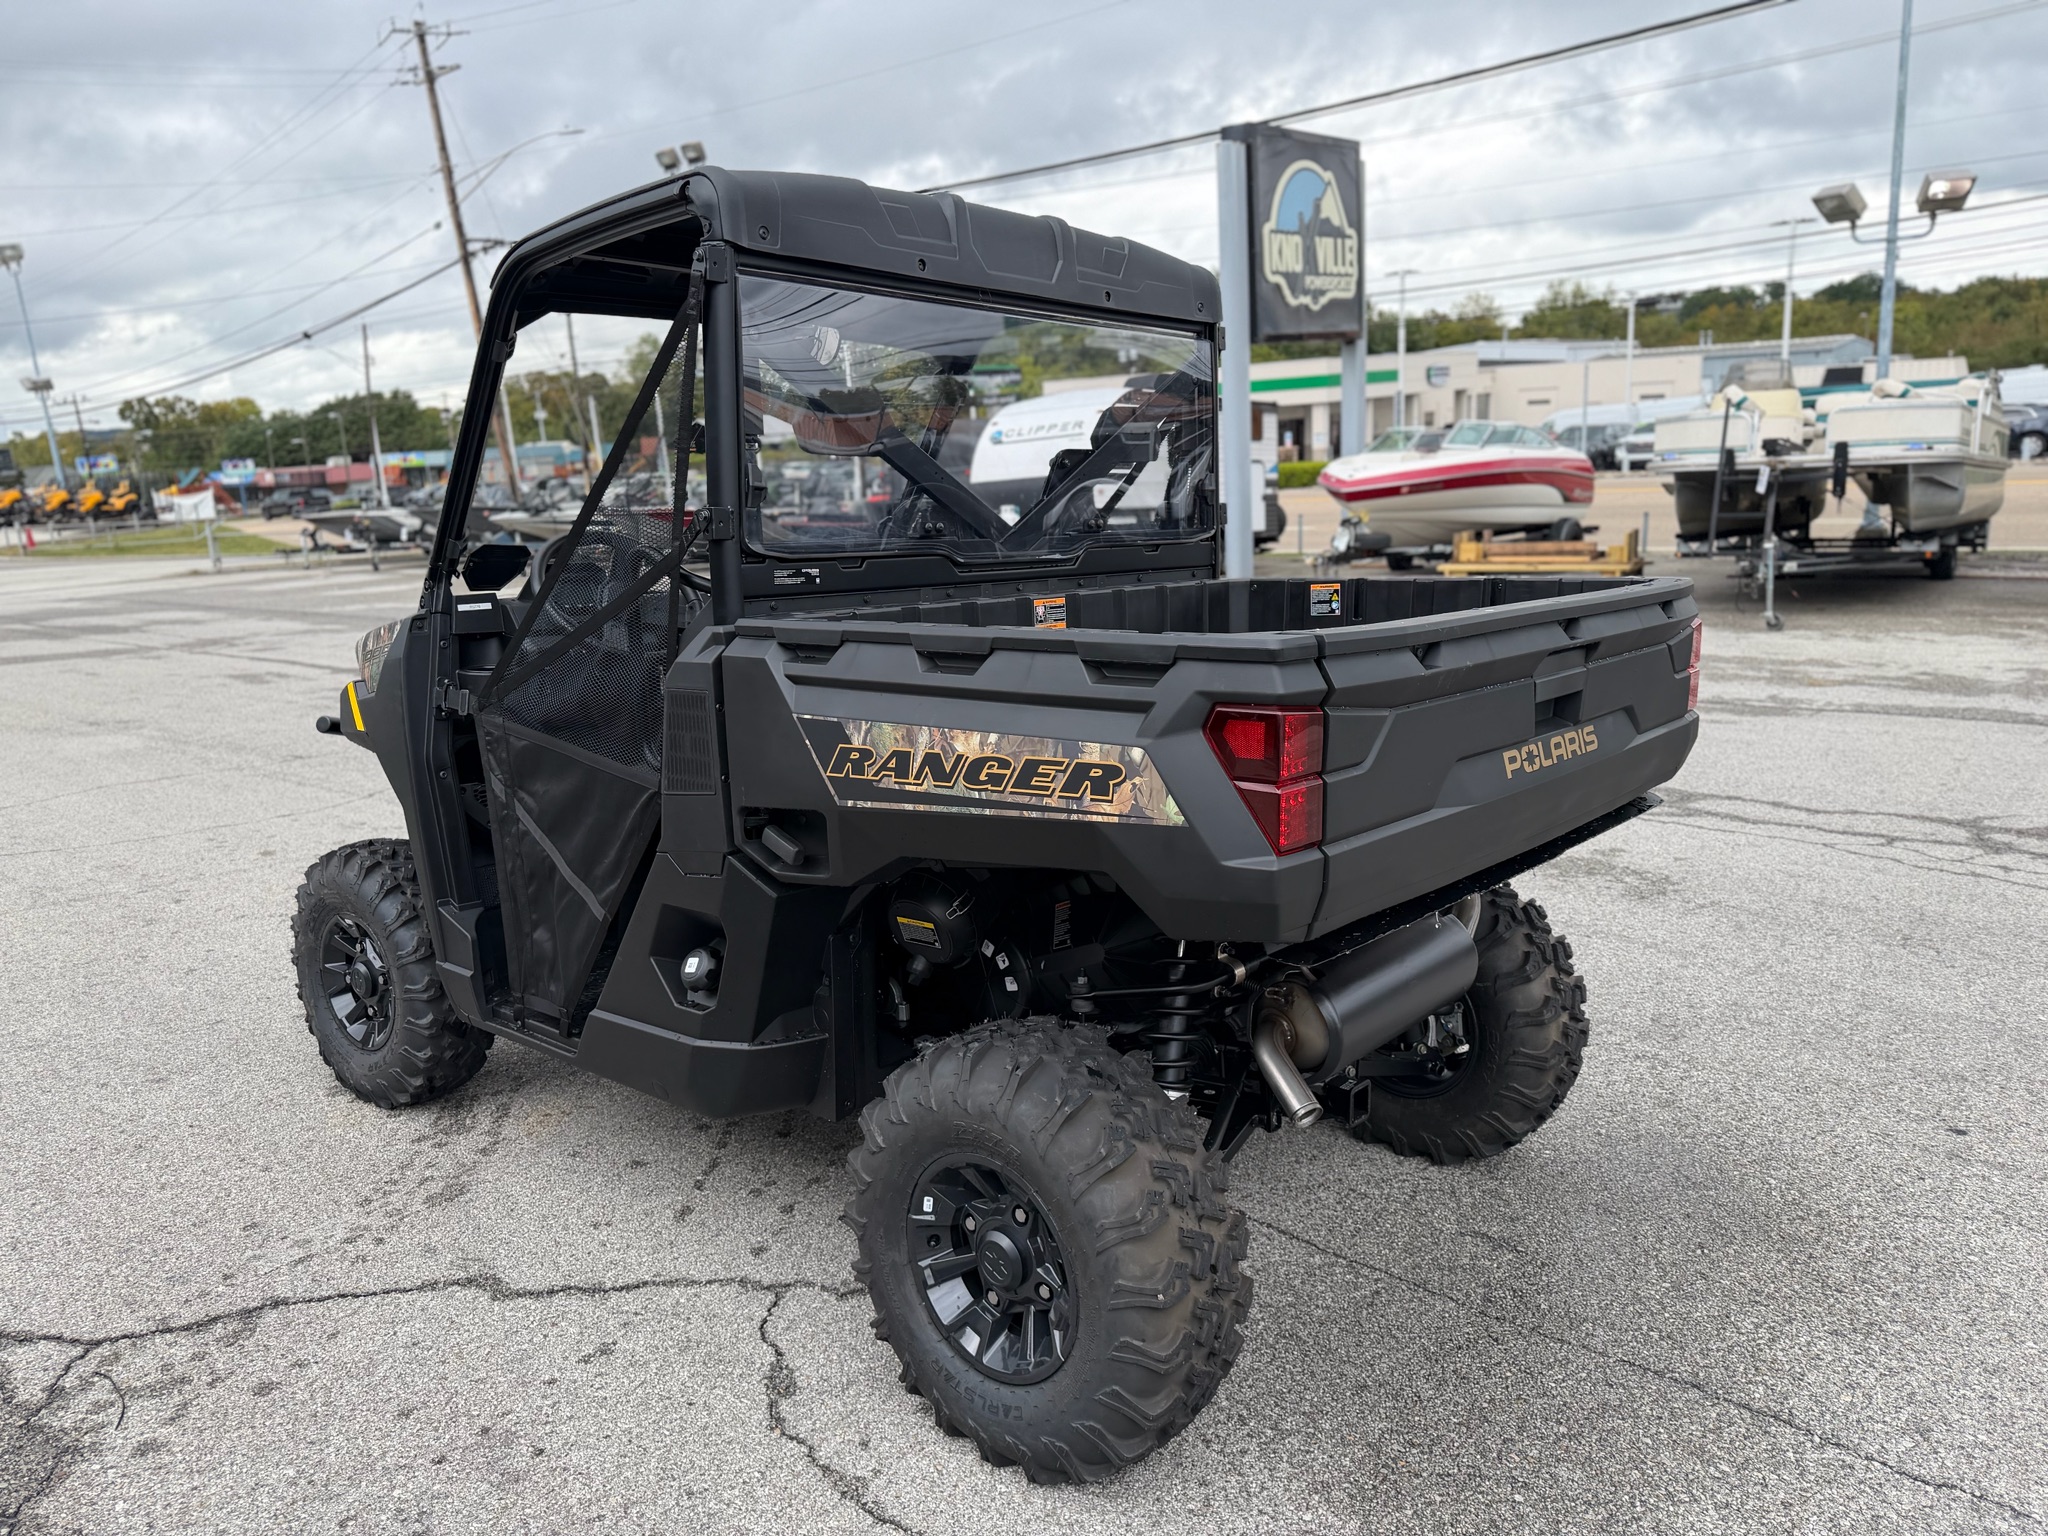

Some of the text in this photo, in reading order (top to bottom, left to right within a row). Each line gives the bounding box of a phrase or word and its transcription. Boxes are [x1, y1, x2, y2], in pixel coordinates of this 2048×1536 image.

[1005, 420, 1084, 438] CLIPPER
[826, 744, 1126, 803] RANGER
[1502, 725, 1598, 779] POLARIS
[929, 1357, 1023, 1421] CARLSTAR
